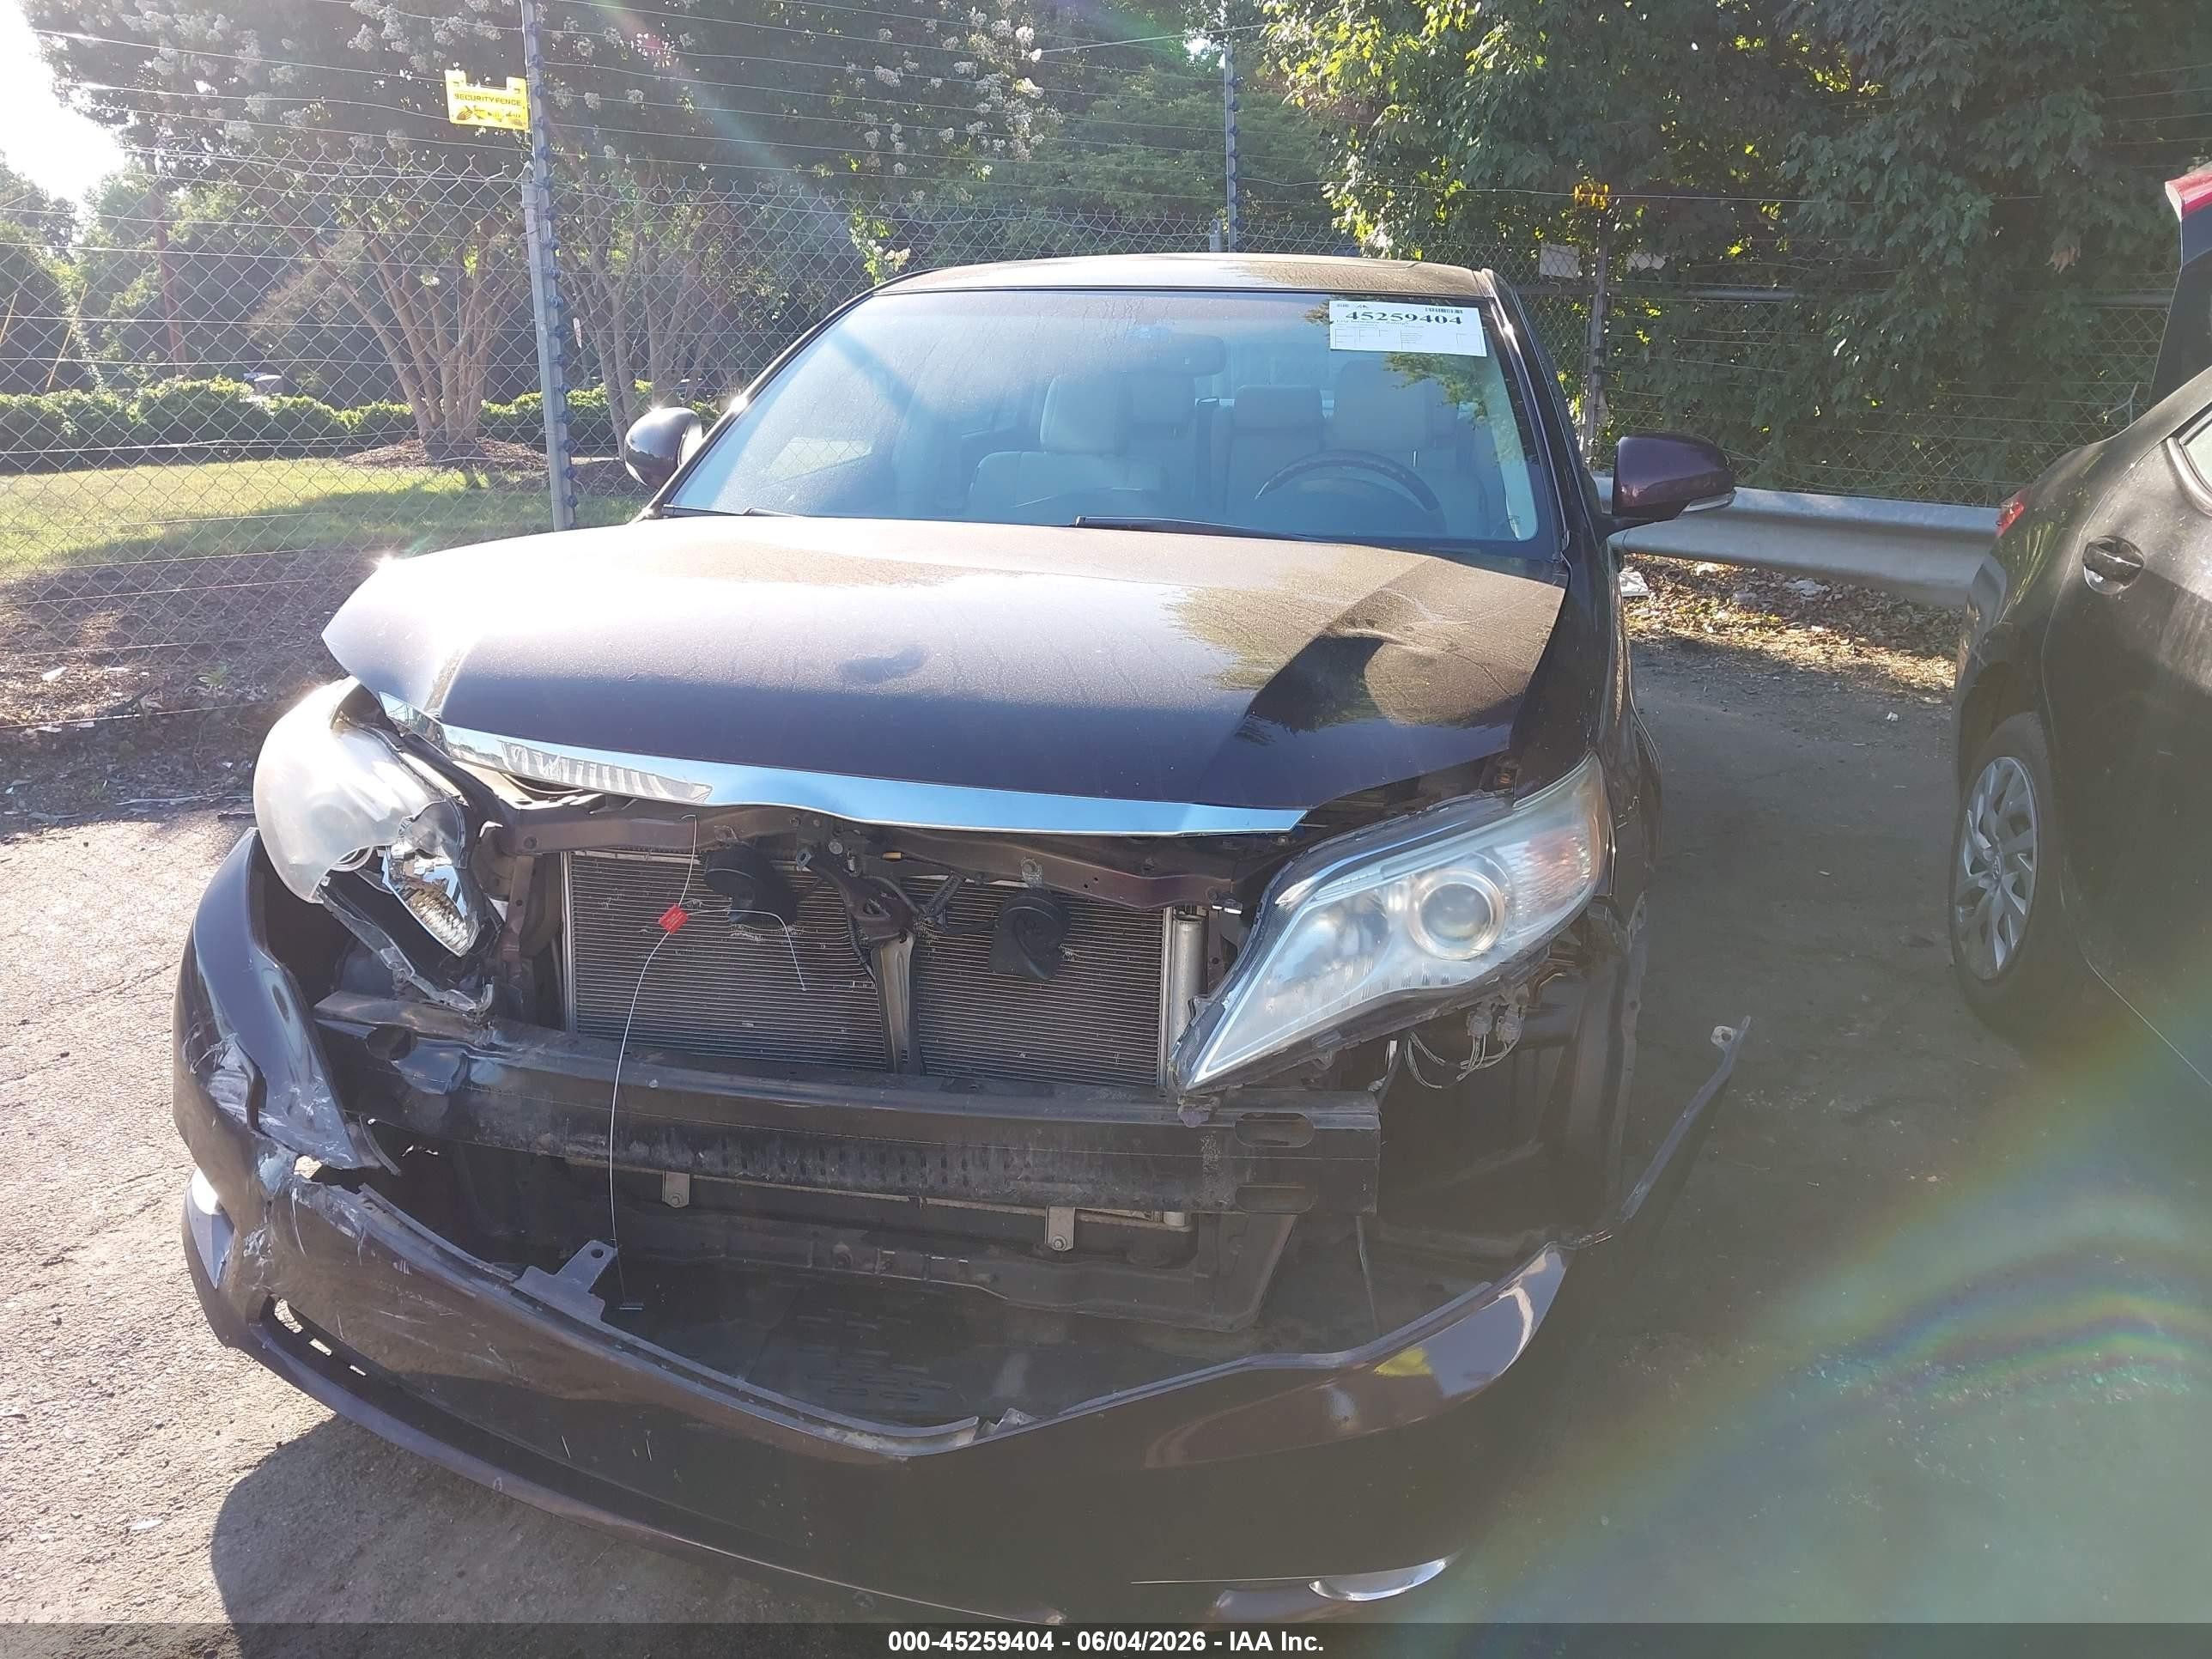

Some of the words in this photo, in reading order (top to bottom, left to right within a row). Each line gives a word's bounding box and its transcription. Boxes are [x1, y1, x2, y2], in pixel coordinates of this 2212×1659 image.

[454, 93, 495, 103] SECURITY
[495, 97, 521, 106] FENCE
[1346, 311, 1463, 325] 45259404
